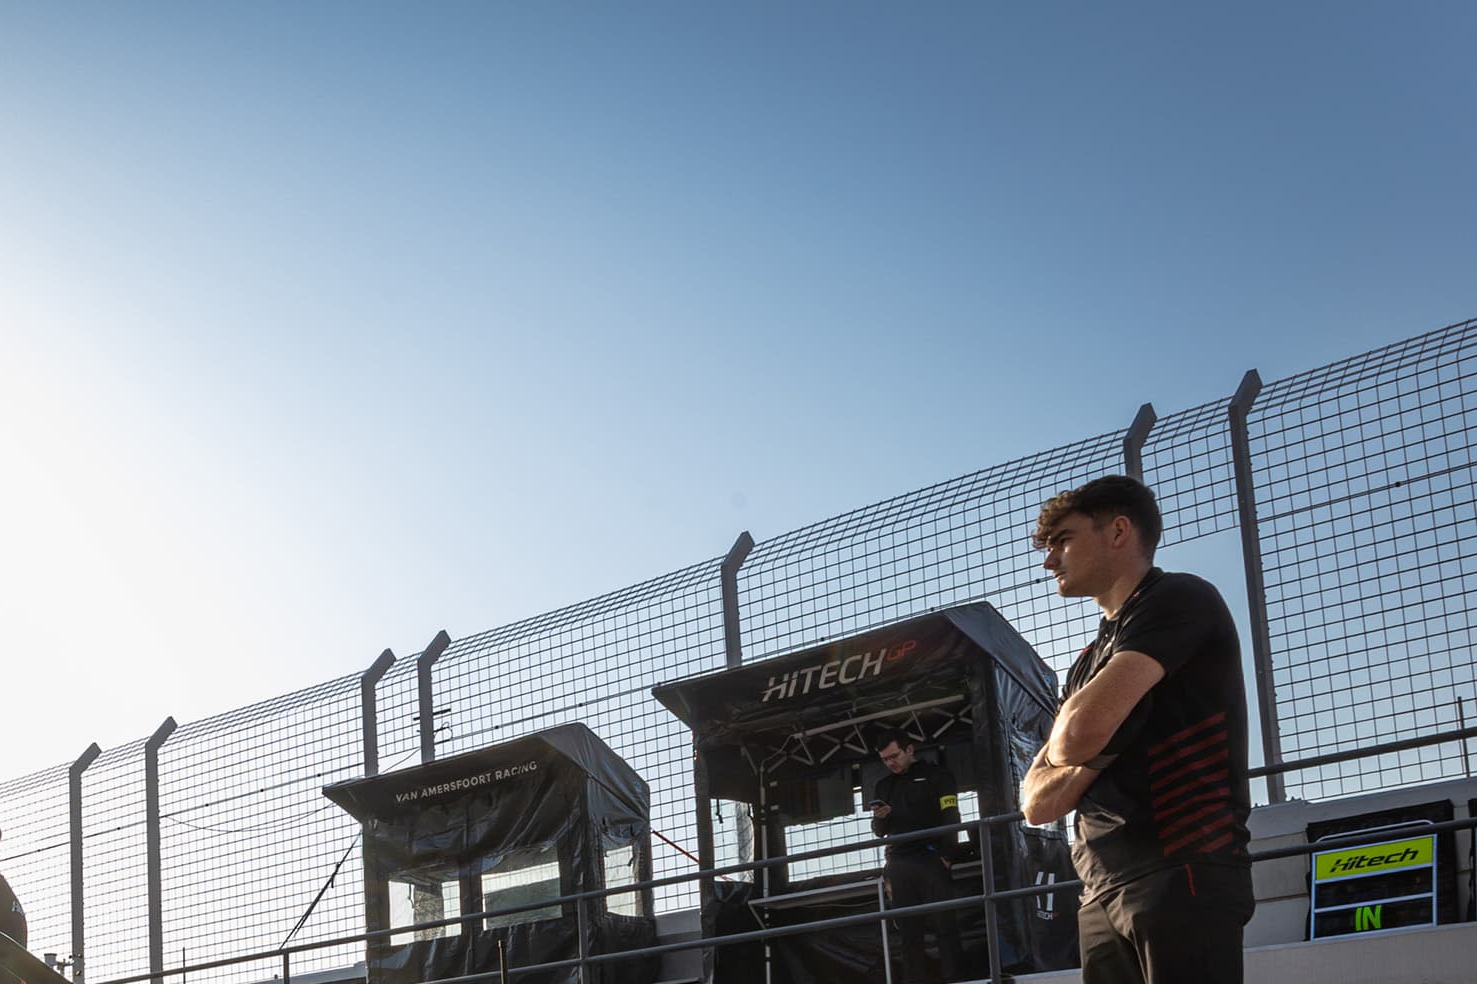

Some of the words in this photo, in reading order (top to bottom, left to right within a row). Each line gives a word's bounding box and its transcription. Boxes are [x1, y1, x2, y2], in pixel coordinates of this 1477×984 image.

[396, 791, 418, 803] VAN
[420, 773, 492, 798] AMERSFOORT
[495, 761, 538, 780] RACING
[1330, 848, 1420, 873] Hitech
[1356, 904, 1382, 931] IN
